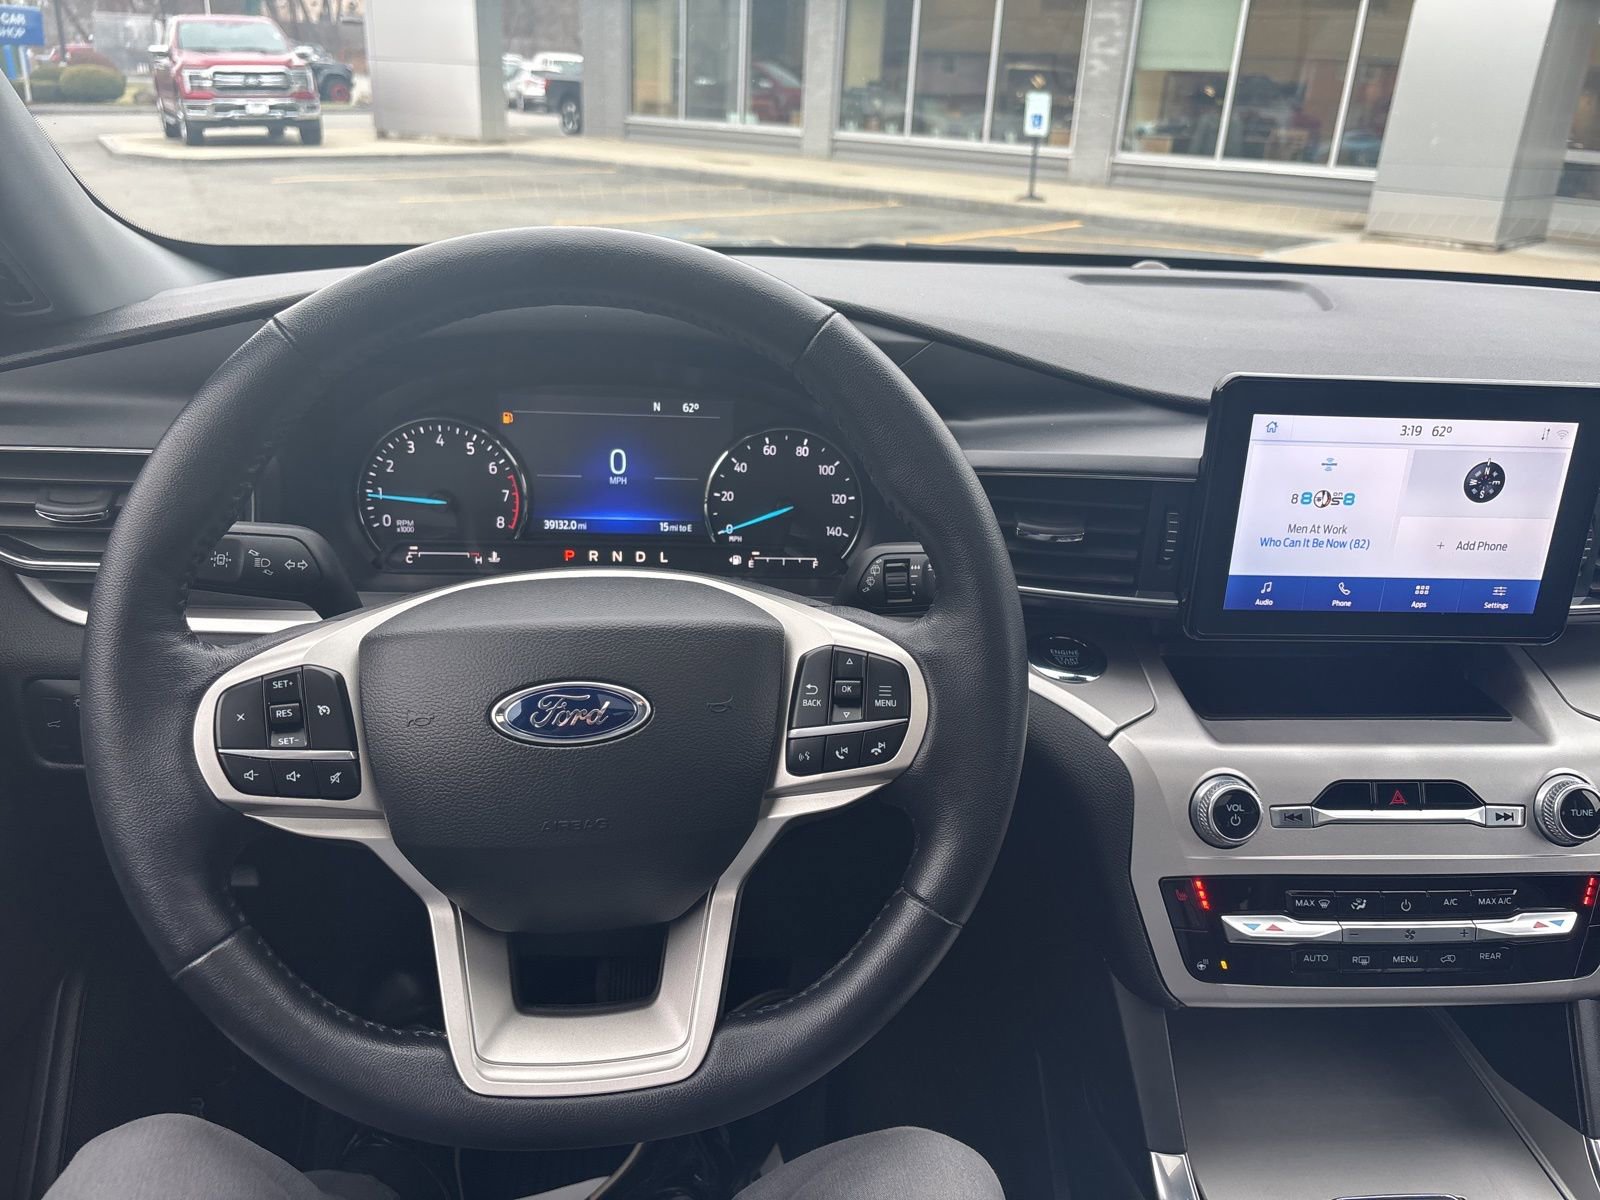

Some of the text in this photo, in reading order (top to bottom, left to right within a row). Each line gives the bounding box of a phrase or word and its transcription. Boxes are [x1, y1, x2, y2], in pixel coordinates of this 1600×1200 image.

[0, 26, 26, 38] HOP
[653, 401, 661, 412] N
[1400, 424, 1423, 437] 3:19
[435, 433, 445, 447] 4
[406, 440, 416, 454] 3
[466, 441, 475, 455] 5
[762, 445, 777, 456] 60
[795, 445, 810, 457] 80
[386, 460, 395, 473] 2
[609, 448, 627, 476] 0
[734, 462, 748, 473] 40
[488, 461, 498, 475] 6
[818, 464, 836, 476] 100
[1485, 466, 1491, 475] N
[609, 476, 628, 485] MPH
[377, 487, 383, 500] 1
[501, 489, 510, 503] 7
[721, 490, 734, 502] 20
[831, 493, 847, 505] 120
[382, 513, 391, 527] 0
[496, 515, 505, 529] 8
[543, 520, 587, 530] 39132.0 mi
[659, 521, 693, 532] 15 mi to E
[725, 523, 734, 535] 0
[826, 526, 843, 537] 140
[1287, 523, 1348, 535] Men At Work
[728, 535, 743, 543] MPH
[1259, 536, 1371, 550] Who Can It Be Now (82)
[1455, 540, 1508, 552] Add Phone
[405, 554, 413, 564] C
[475, 556, 483, 565] H
[564, 550, 669, 563] P R N D L
[748, 559, 755, 569] E
[812, 559, 819, 569] F
[1254, 598, 1274, 606] Audio
[1331, 599, 1352, 607] Phone
[1410, 601, 1427, 609] Apps
[1483, 601, 1509, 610] Settings
[841, 685, 852, 693] OK
[802, 699, 821, 707] BACK
[874, 699, 897, 707] MENU
[276, 708, 293, 718] RES
[529, 694, 610, 728] Ford
[1226, 803, 1245, 812] VOL
[1570, 808, 1594, 817] TUNE
[1295, 899, 1316, 908] MAX
[1443, 898, 1459, 907] A/C
[1478, 897, 1513, 906] MAX A/C
[1303, 953, 1329, 963] AUTO
[1392, 954, 1419, 963] MENU
[1479, 952, 1502, 961] REAR
